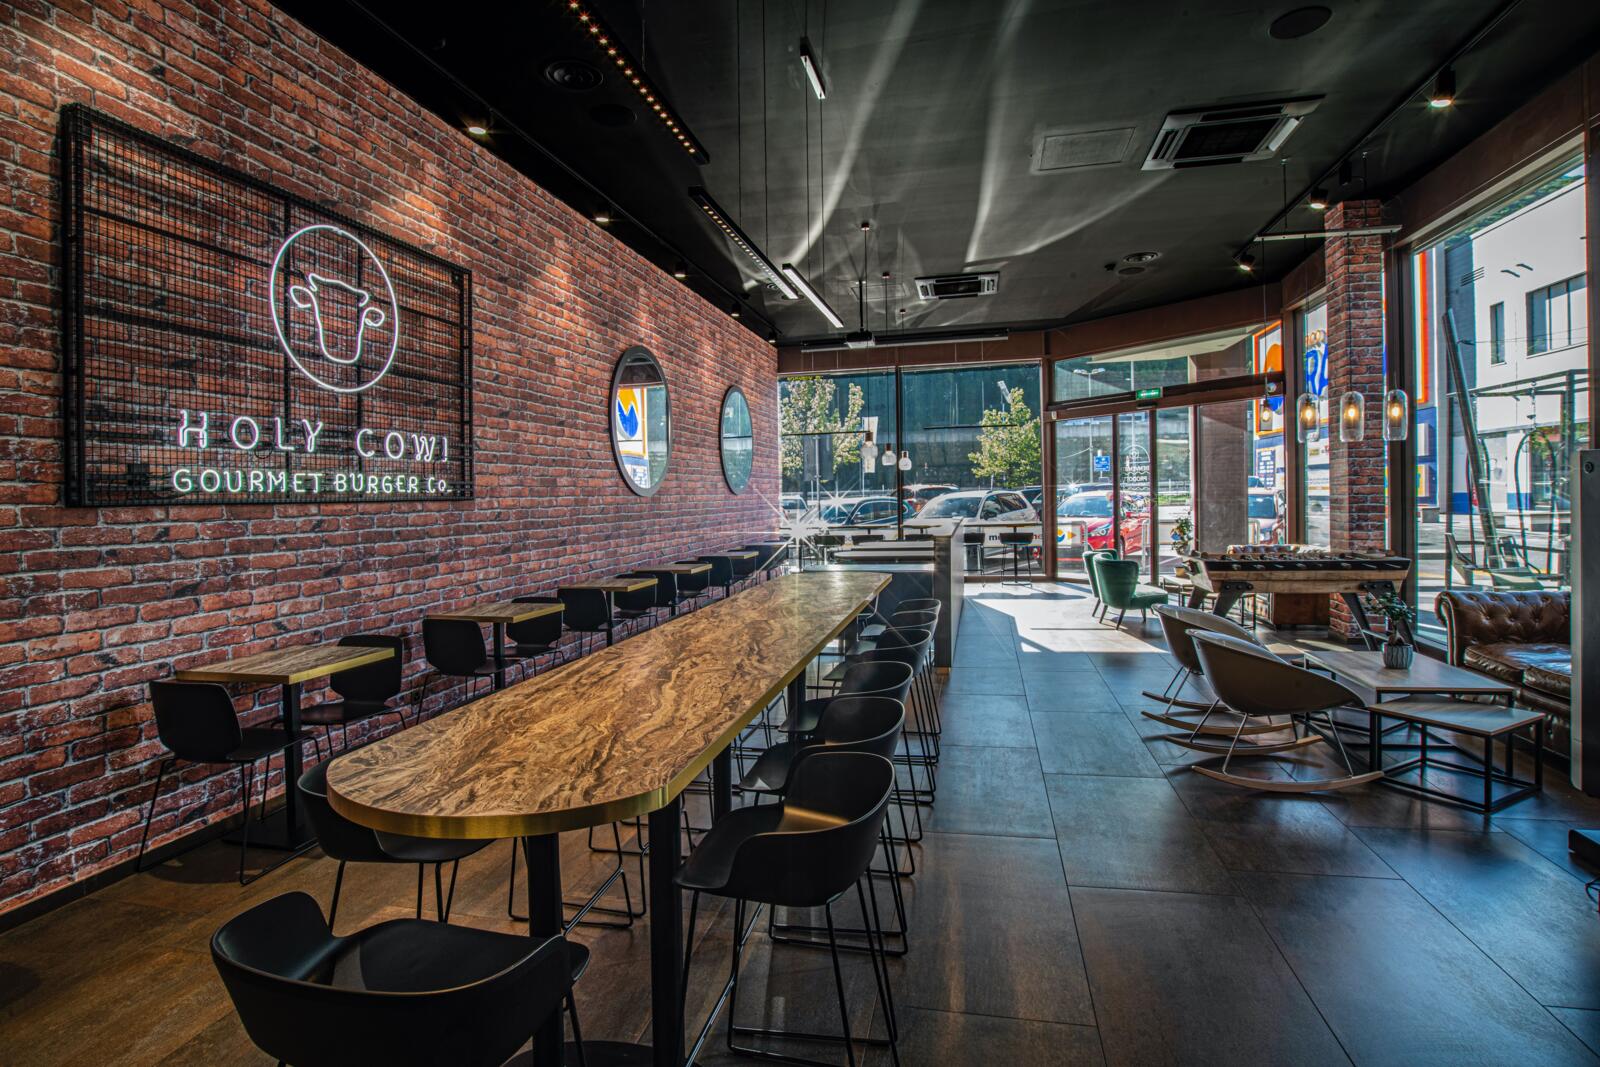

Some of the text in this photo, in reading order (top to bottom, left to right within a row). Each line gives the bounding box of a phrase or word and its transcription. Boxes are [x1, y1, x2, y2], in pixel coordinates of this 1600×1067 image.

[178, 408, 324, 453] HOLY
[172, 468, 323, 493] GOURMET
[333, 472, 419, 494] BURGER
